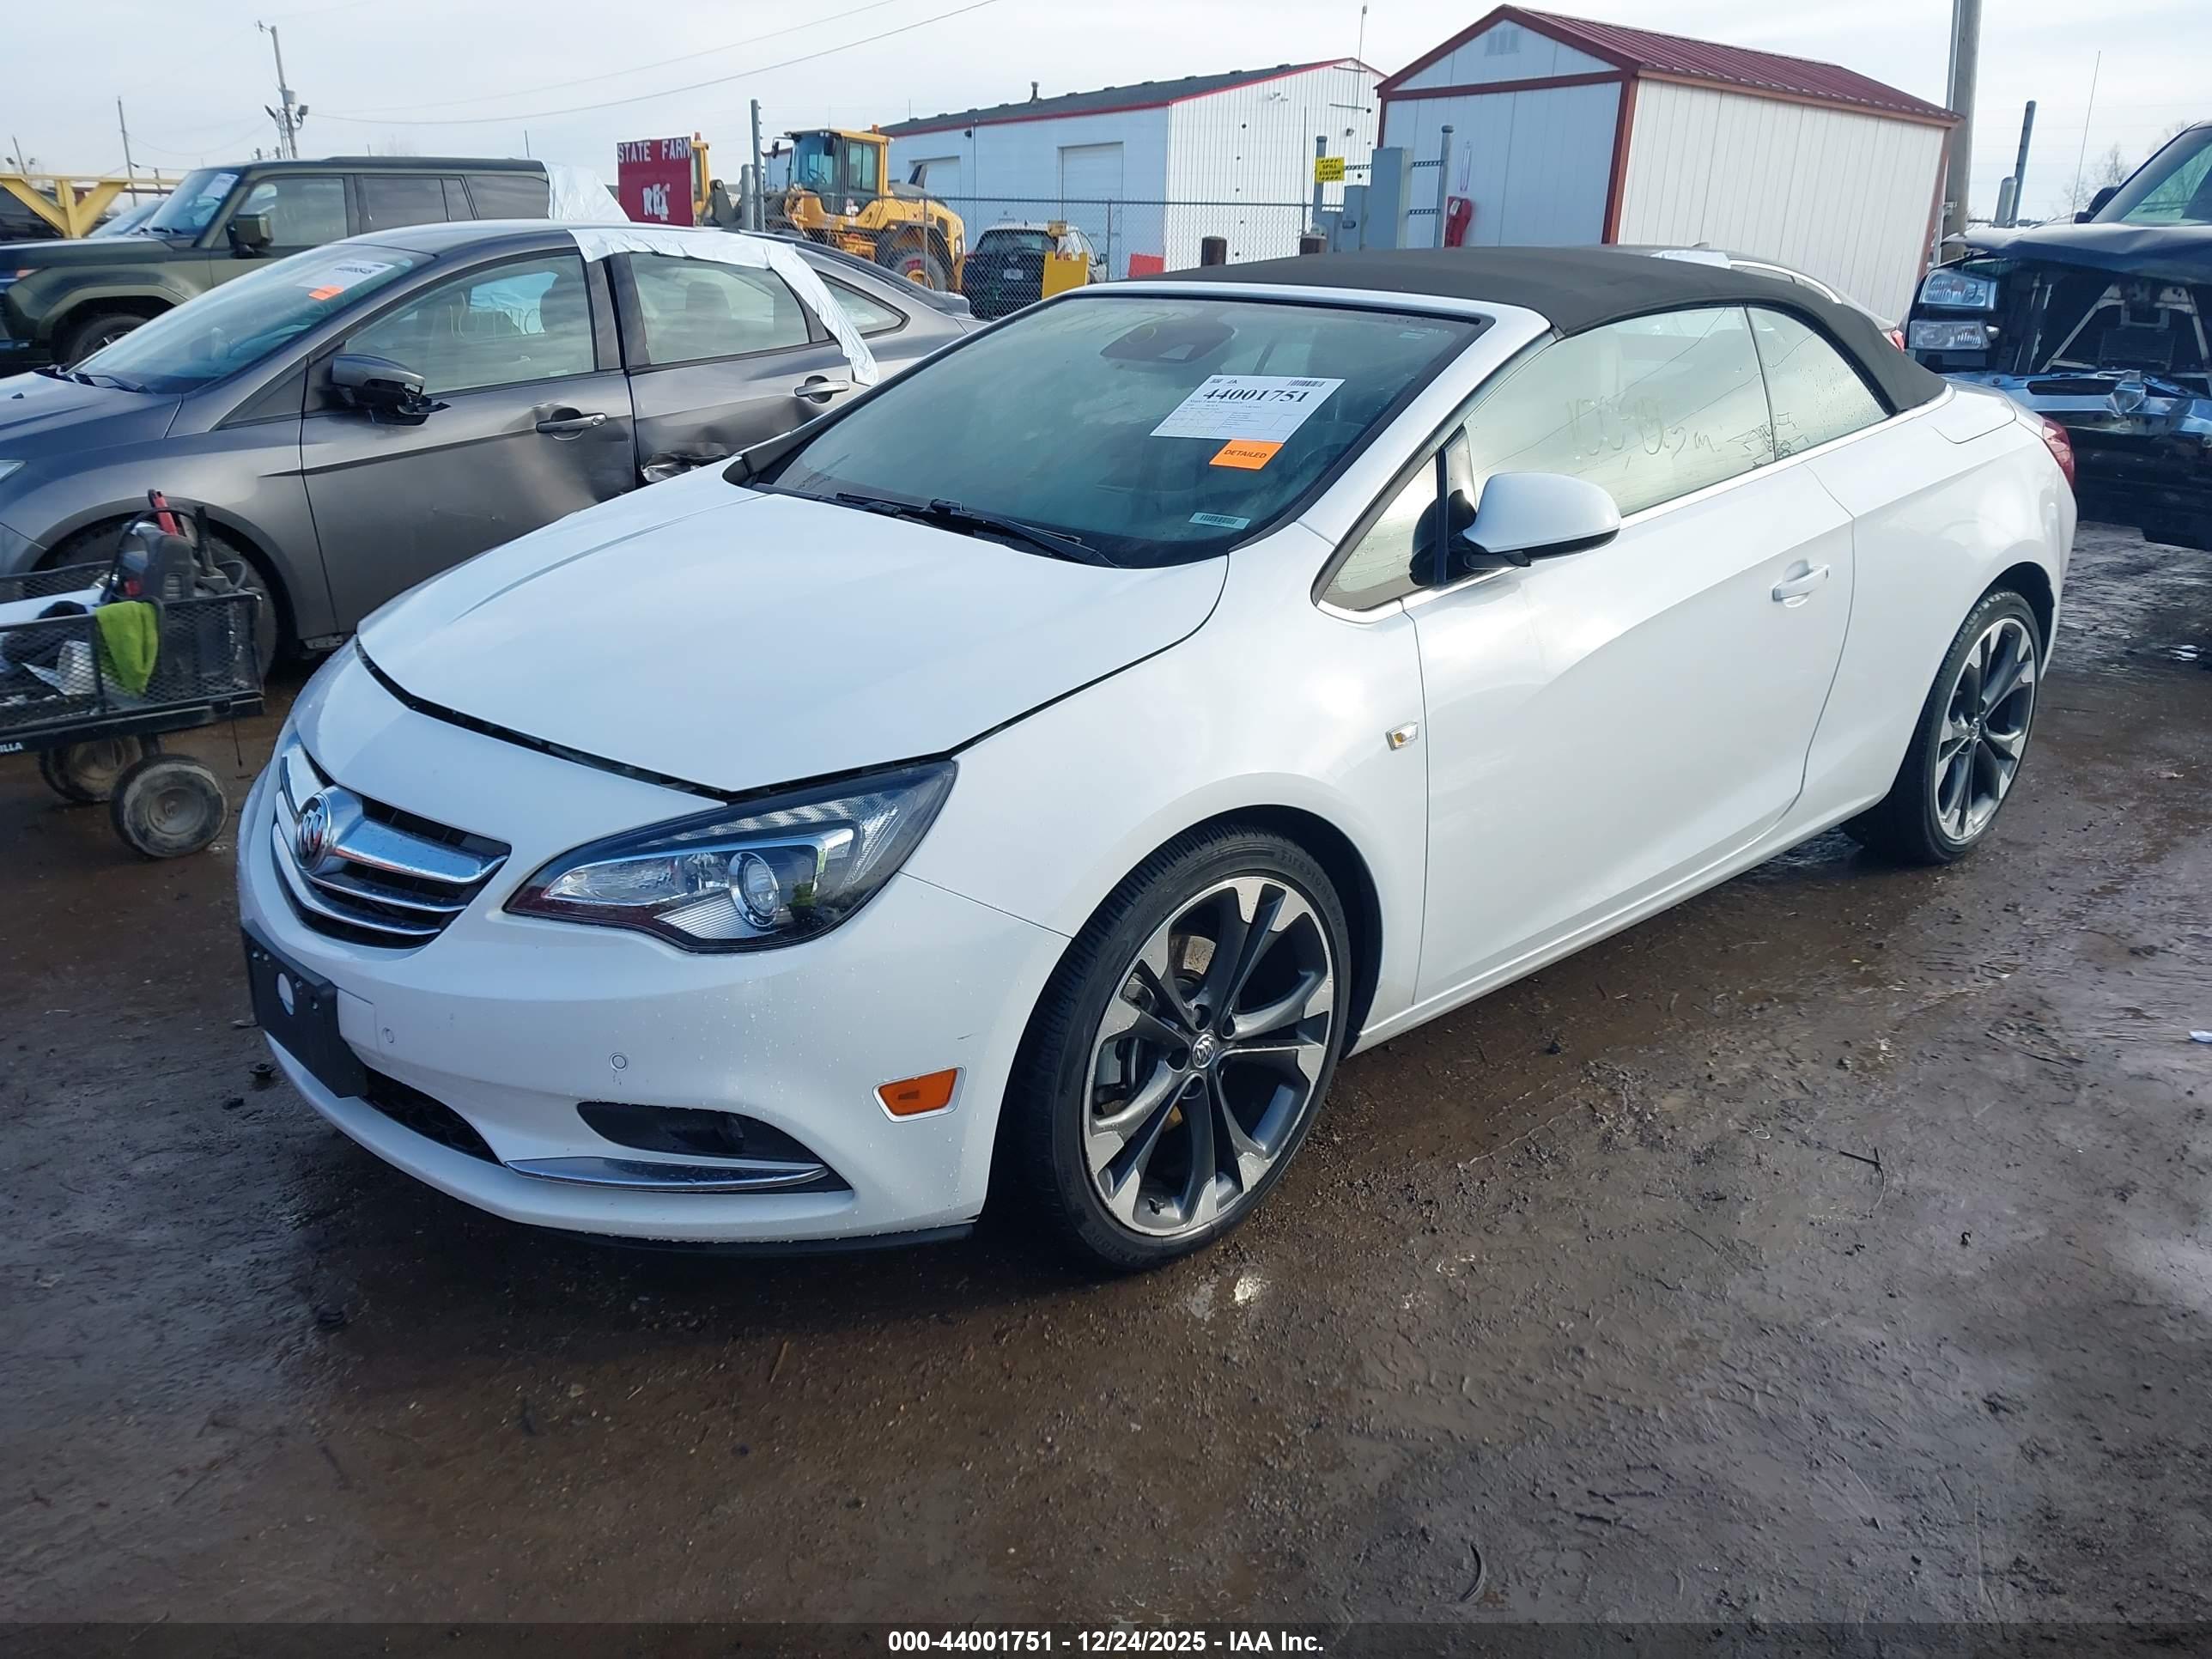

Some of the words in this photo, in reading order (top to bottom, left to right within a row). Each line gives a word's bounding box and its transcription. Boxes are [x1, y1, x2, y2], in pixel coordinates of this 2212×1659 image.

[617, 143, 652, 163] STATE
[661, 138, 690, 161] FARM
[1203, 388, 1311, 404] 44001751
[1224, 448, 1267, 459] DETAILED
